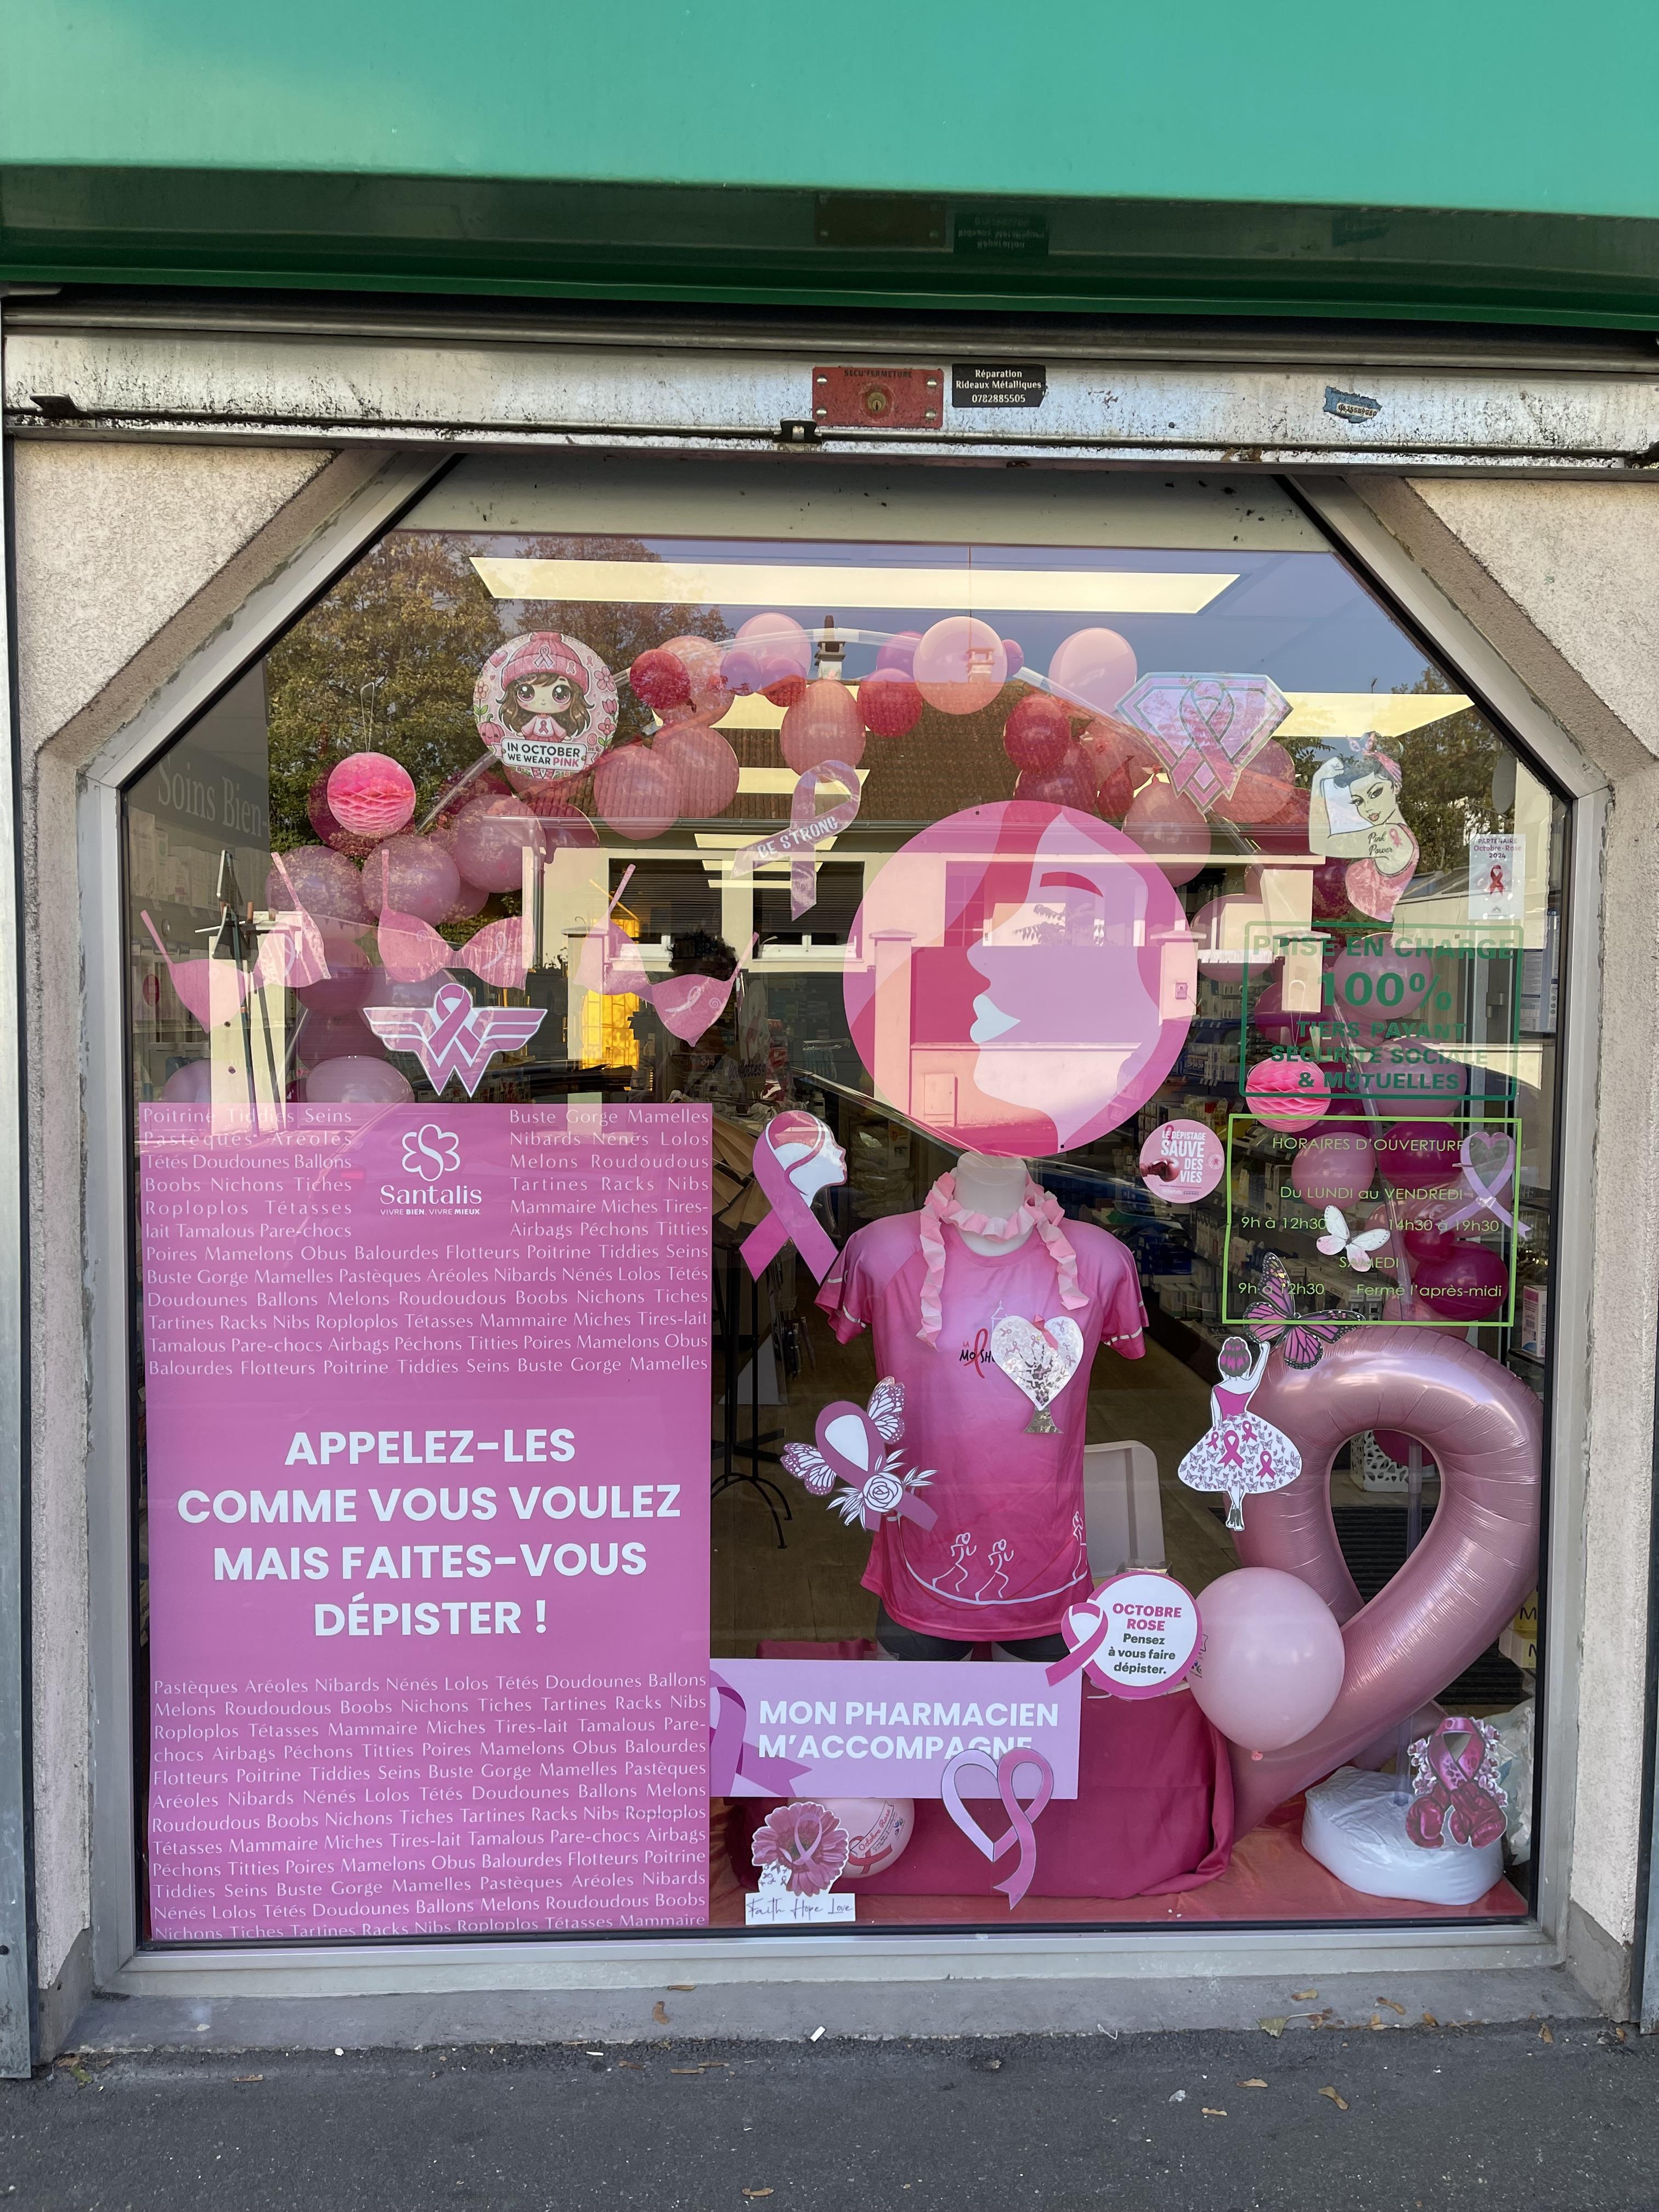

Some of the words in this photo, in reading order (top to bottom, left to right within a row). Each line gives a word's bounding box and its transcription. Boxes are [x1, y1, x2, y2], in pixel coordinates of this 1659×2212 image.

[975, 368, 1023, 379] Réparation
[956, 380, 989, 390] Rideaux
[991, 379, 1042, 391] Métalliques
[972, 393, 1026, 404] 0782885505
[507, 742, 518, 752] IN
[521, 744, 580, 758] OCTOBER
[507, 753, 521, 762] WE
[523, 755, 551, 765] WEAR
[552, 757, 579, 767] PINK
[157, 755, 216, 821] Soins
[757, 839, 777, 859] BE
[780, 816, 838, 849] STRONG
[1368, 831, 1387, 844] Pink
[1368, 844, 1393, 856] Power
[1253, 935, 1335, 957] PRISE
[1346, 936, 1384, 957] EN
[1395, 937, 1515, 960] CHARGE
[1318, 971, 1452, 1011] 100%
[1296, 1021, 1360, 1039] TIERS
[1370, 1022, 1466, 1040] PAYANT
[1390, 1047, 1488, 1065] SOCIALE
[1298, 1071, 1314, 1088] &
[1323, 1071, 1460, 1090] MUTUELLES
[1161, 1130, 1171, 1139] LE
[1171, 1130, 1206, 1141] DÉPISTAGE
[1272, 1137, 1351, 1150] HORAIRES
[1160, 1139, 1206, 1158] SAUVE
[145, 1153, 188, 1169] Tétés
[193, 1153, 290, 1169] Doudounes
[295, 1153, 352, 1169] Ballons
[510, 1153, 578, 1169] Melons
[591, 1153, 708, 1168] Roudoudous
[1184, 1158, 1203, 1171] DES
[145, 1177, 200, 1192] Boobs
[211, 1176, 283, 1192] Nichons
[294, 1176, 352, 1192] Tiches
[1180, 1170, 1203, 1183] VIES
[380, 1184, 483, 1205] Santalis
[1280, 1186, 1302, 1199] Du
[1307, 1187, 1353, 1199] LUNDI
[1357, 1189, 1379, 1200] au
[1384, 1187, 1463, 1200] VENDREDI
[146, 1223, 169, 1238] lait
[176, 1222, 255, 1238] Tamalous
[261, 1222, 352, 1238] Pare-chocs
[510, 1221, 572, 1240] Airbags
[580, 1221, 648, 1236] Péchons
[656, 1221, 708, 1235] Titties
[1241, 1216, 1260, 1228] 9h
[1265, 1216, 1276, 1229] à
[1283, 1217, 1327, 1230] 12h30
[1389, 1219, 1433, 1231] 14h30
[1455, 1220, 1499, 1232] 19h30
[147, 1246, 197, 1261] Poires
[205, 1245, 294, 1261] Mamelons
[301, 1245, 347, 1260] Obus
[355, 1244, 438, 1260] Balourdes
[447, 1244, 520, 1260] Flotteurs
[528, 1244, 591, 1259] Poitrine
[598, 1243, 659, 1259] Tiddies
[666, 1244, 708, 1258] Seins
[1238, 1282, 1257, 1294] 9h
[1281, 1283, 1325, 1295] 12h30
[1356, 1283, 1405, 1296] Fermé
[1410, 1284, 1502, 1299] l'après-midi
[148, 1291, 247, 1307] Doudounes
[257, 1291, 318, 1306] Ballons
[328, 1290, 390, 1306] Melons
[399, 1290, 506, 1305] Roudoudous
[516, 1289, 568, 1305] Boobs
[577, 1289, 645, 1304] Nichons
[653, 1288, 708, 1303] Tiches
[149, 1360, 233, 1375] Balourdes
[241, 1360, 315, 1375] Flotteurs
[324, 1358, 388, 1374] Poitrine
[397, 1358, 459, 1374] Tiddies
[467, 1358, 510, 1373] Seins
[518, 1358, 563, 1372] Buste
[571, 1357, 621, 1374] Gorge
[629, 1356, 708, 1370] Mamelles
[284, 1428, 575, 1465] APPELEZ-LES
[178, 1489, 357, 1523] COMME
[368, 1487, 497, 1522] VOUS
[508, 1484, 681, 1520] VOULEZ
[214, 1547, 329, 1581] MAIS
[342, 1542, 647, 1579] FAITES-VOUS
[315, 1592, 521, 1636] DÉPISTER
[1113, 1603, 1182, 1618] OCTOBRE
[1126, 1618, 1165, 1631] ROSE
[1123, 1633, 1165, 1645] Pensez
[1108, 1646, 1115, 1657] à
[1118, 1649, 1147, 1658] vous
[1148, 1649, 1176, 1660] faire
[1114, 1662, 1167, 1674] dépister.
[155, 1680, 238, 1699] Pastèques
[245, 1678, 308, 1693] Aréoles
[315, 1677, 379, 1692] Nibards
[386, 1678, 438, 1691] Nénés
[445, 1676, 488, 1691] Lolos
[495, 1676, 539, 1690] Tétés
[546, 1674, 641, 1689] Doudounes
[649, 1672, 706, 1687] Ballons
[760, 1700, 837, 1725] MON
[845, 1702, 1058, 1726] PHARMACIEN
[154, 1770, 228, 1785] Flotteurs
[237, 1768, 301, 1782] Poitrine
[309, 1765, 370, 1781] Tiddies
[378, 1765, 420, 1780] Seins
[429, 1764, 473, 1779] Buste
[481, 1763, 531, 1781] Gorge
[539, 1761, 617, 1776] Mamelles
[625, 1761, 706, 1780] Pastèques
[154, 1883, 215, 1898] Tiddies
[224, 1883, 268, 1898] Seins
[277, 1882, 322, 1897] Buste
[331, 1881, 382, 1897] Gorge
[392, 1876, 471, 1892] Mamelles
[481, 1876, 562, 1893] Pastèques
[572, 1872, 634, 1887] Aréoles
[643, 1870, 706, 1885] Nibards
[746, 1897, 785, 1921] Faith
[790, 1897, 823, 1921] Hope
[827, 1898, 854, 1915] Love
